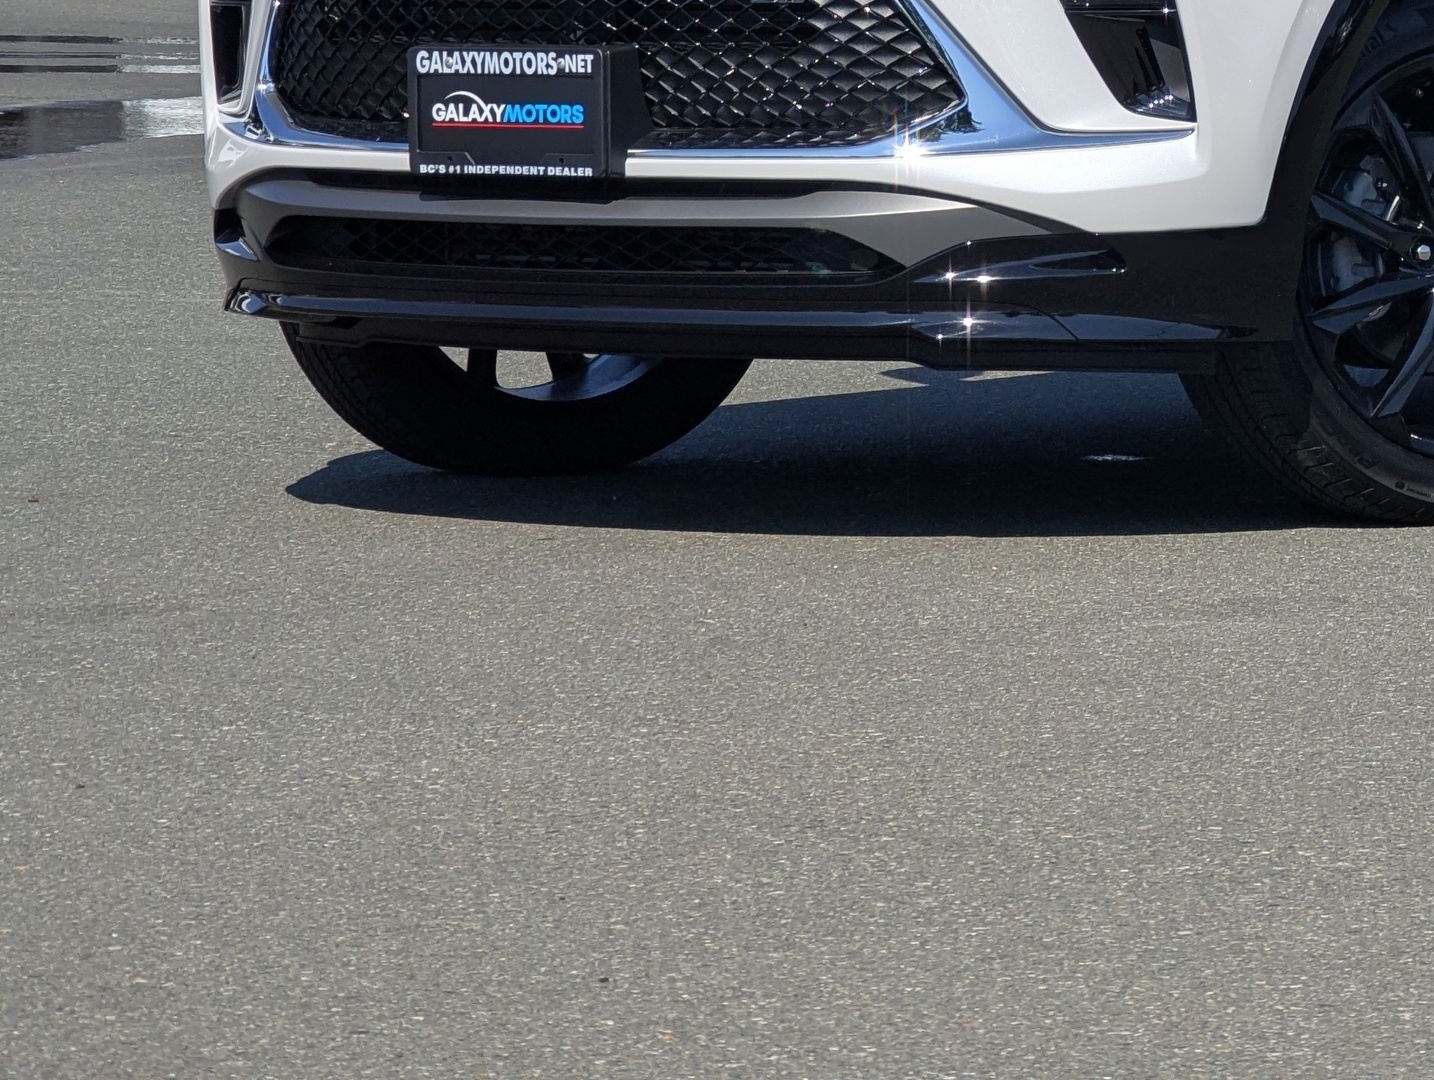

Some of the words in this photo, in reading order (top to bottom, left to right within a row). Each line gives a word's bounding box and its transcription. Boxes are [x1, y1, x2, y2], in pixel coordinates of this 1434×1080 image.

[419, 164, 446, 174] BC'S
[464, 165, 545, 176] INDEPENDENT
[547, 166, 593, 177] DEALER
